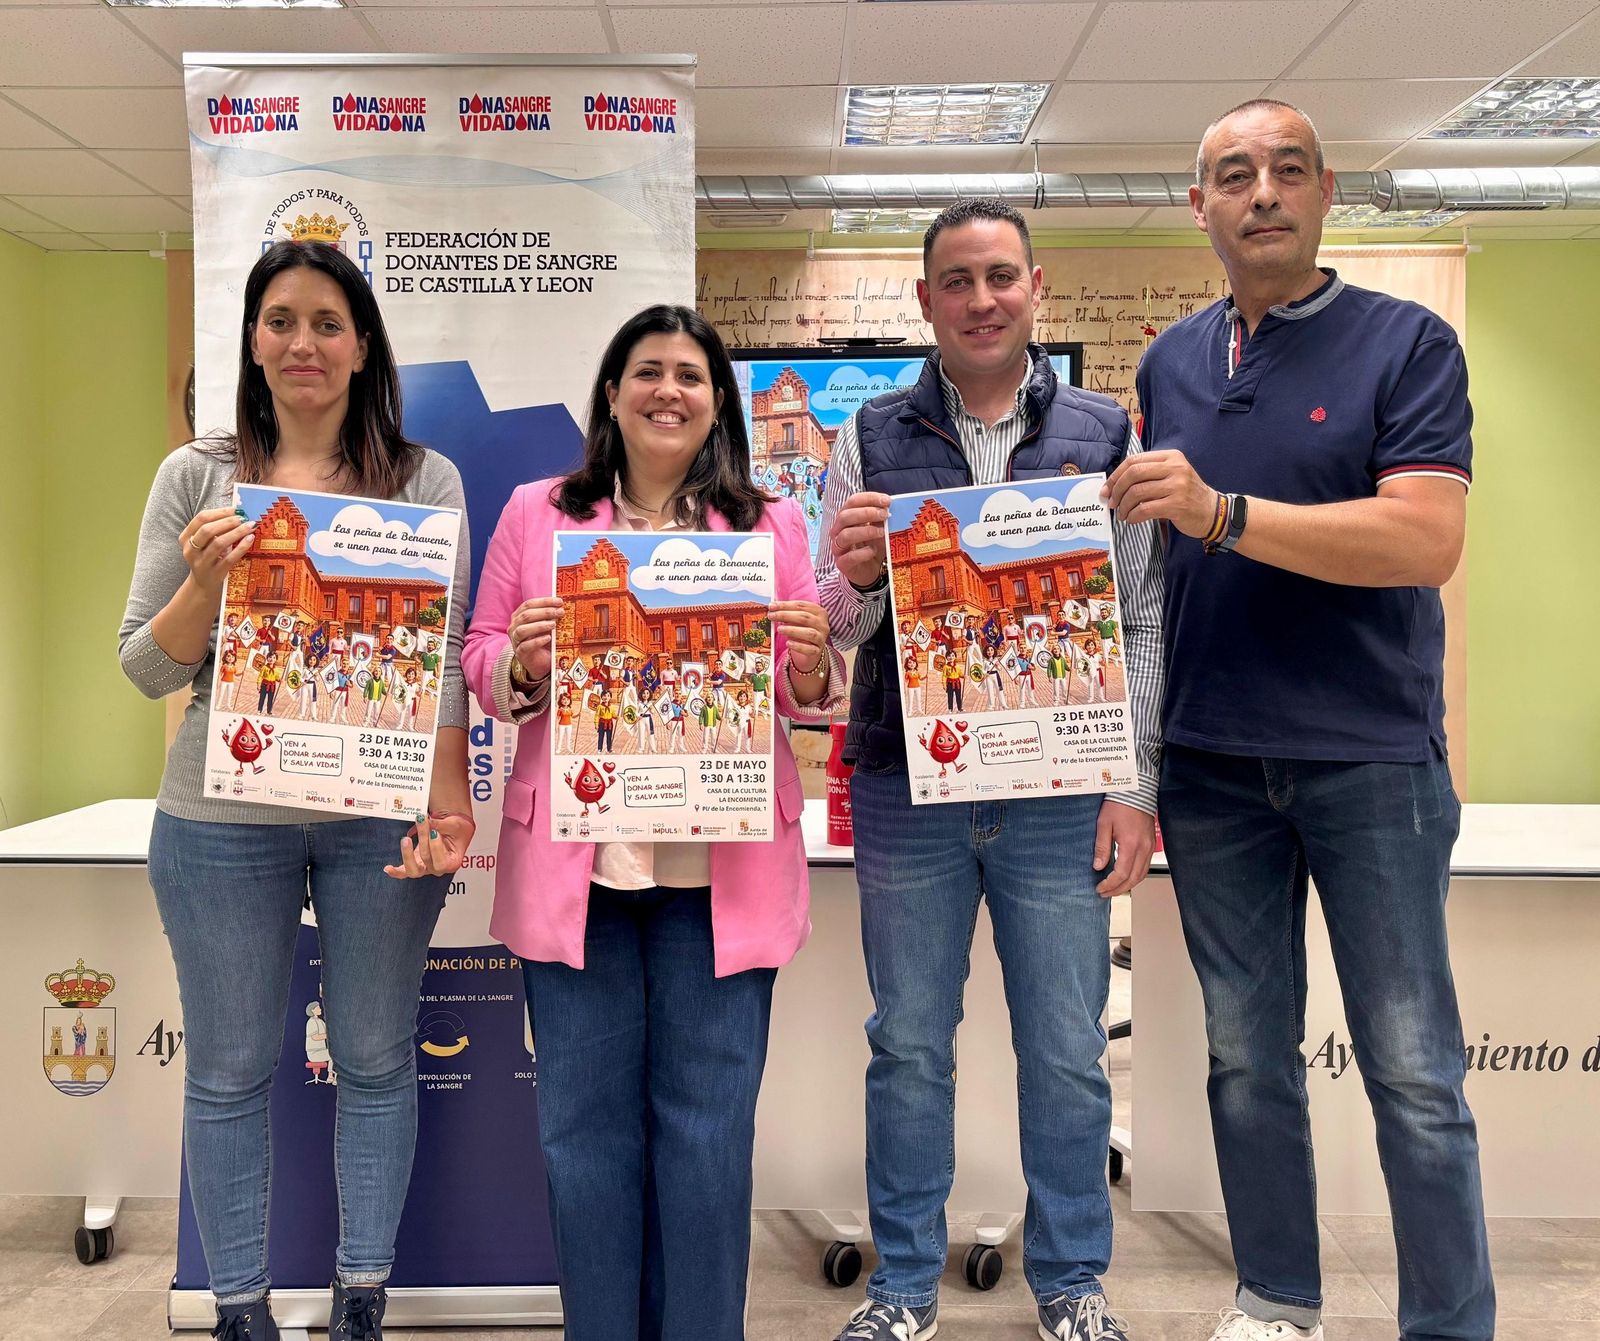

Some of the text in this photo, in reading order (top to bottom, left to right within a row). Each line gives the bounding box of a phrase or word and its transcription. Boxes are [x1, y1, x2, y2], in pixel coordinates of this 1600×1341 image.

[264, 188, 368, 236] DE TODOS Y PARA TODOS
[385, 228, 550, 248] FEDERACIÓN DE
[385, 254, 618, 270] DONANTES DE SANGRE
[386, 277, 594, 293] DE CASTILLA Y LEON
[829, 383, 842, 391] Las
[846, 383, 868, 393] peñas
[983, 504, 1104, 523] Las peñas de Benavente,
[1000, 528, 1023, 536] unen
[1026, 524, 1051, 536] para
[1055, 521, 1073, 530] dar
[1076, 518, 1102, 528] vida.
[333, 524, 452, 547] Las peñas de Benavente,
[347, 543, 370, 552] unen
[372, 546, 398, 554] para
[400, 548, 420, 557] dar
[422, 550, 447, 560] vida.
[653, 558, 769, 569] Las peñas de Benavente,
[693, 575, 718, 584] para
[742, 572, 766, 582] vida.
[1053, 709, 1123, 722] 23 DE MAYO
[1056, 722, 1124, 735] 9:30 A 13:30
[359, 734, 428, 749] 23 DE MAYO
[982, 737, 1038, 749] DONAR SANGRE
[359, 747, 425, 762] 9:30 A 13:30
[700, 761, 766, 769] 23 DE MAYO
[384, 773, 424, 782] ENCOMIENDA
[701, 774, 766, 783] 9:30 A 13:30
[489, 958, 506, 969] DE
